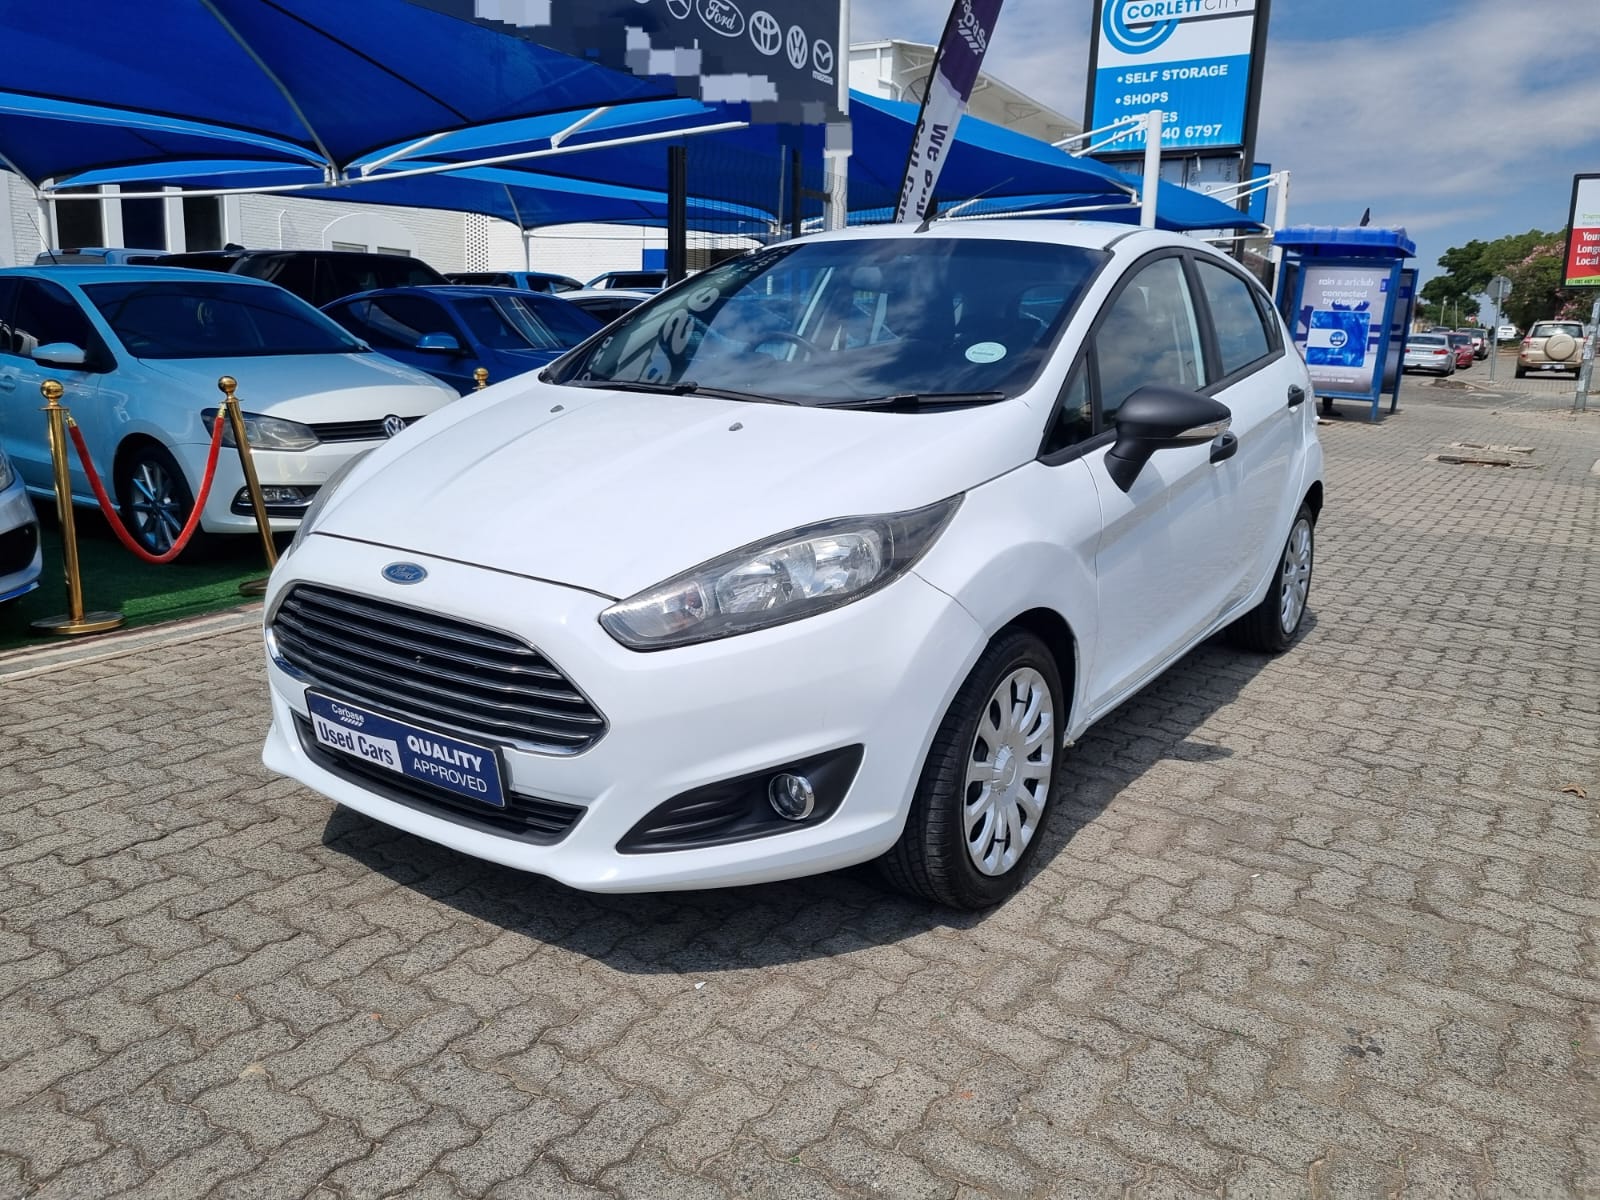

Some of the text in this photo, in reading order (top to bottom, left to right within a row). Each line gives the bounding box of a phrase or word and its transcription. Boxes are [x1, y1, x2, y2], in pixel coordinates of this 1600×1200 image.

[706, 0, 736, 30] Ford
[1127, 0, 1200, 19] CORLETT
[1124, 64, 1228, 84] SELF STORAGE
[1123, 92, 1169, 105] SHOPS
[1161, 126, 1180, 140] 40
[1184, 124, 1223, 139] 6797
[927, 123, 949, 162] We
[1576, 256, 1599, 266] Local
[331, 703, 365, 723] Carbase
[318, 720, 394, 766] Used Cars
[406, 735, 482, 773] QUALITY
[413, 757, 487, 793] APPROVED
